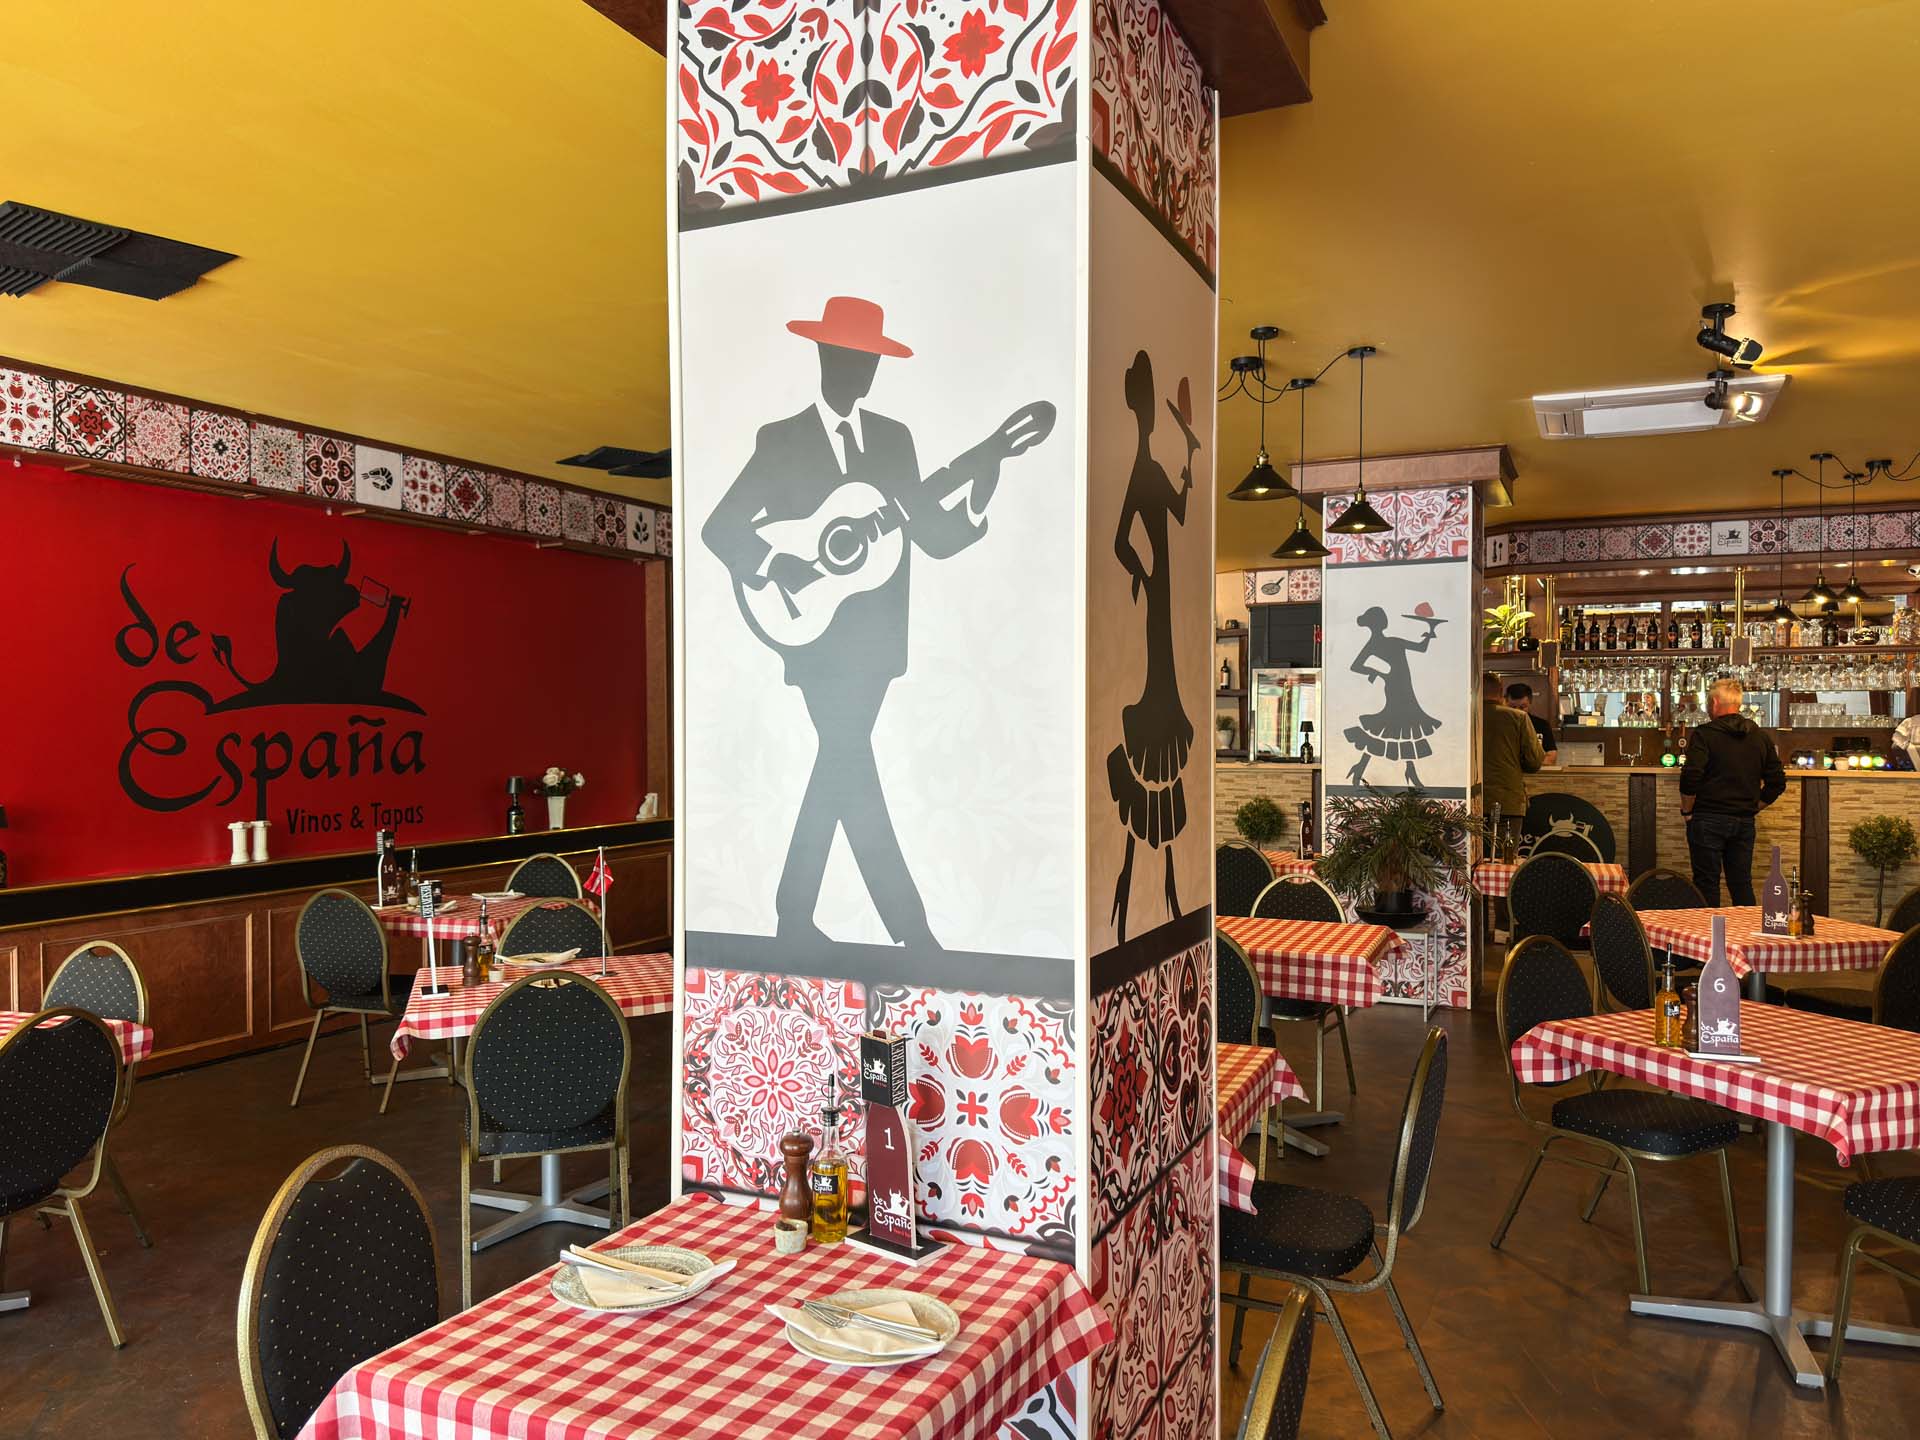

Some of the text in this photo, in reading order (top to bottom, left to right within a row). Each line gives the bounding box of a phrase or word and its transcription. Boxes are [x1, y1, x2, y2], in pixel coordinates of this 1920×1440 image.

[115, 562, 200, 668] de
[118, 680, 428, 822] España
[286, 802, 424, 835] Vinos & Tapas
[383, 864, 394, 873] 14
[1773, 885, 1782, 896] 5
[1713, 977, 1726, 993] 6
[1700, 1020, 1711, 1031] de
[1701, 1030, 1739, 1048] España
[863, 1067, 888, 1085] España
[891, 1041, 906, 1105] RESERVERET
[884, 1127, 895, 1150] 1
[873, 1188, 883, 1205] de
